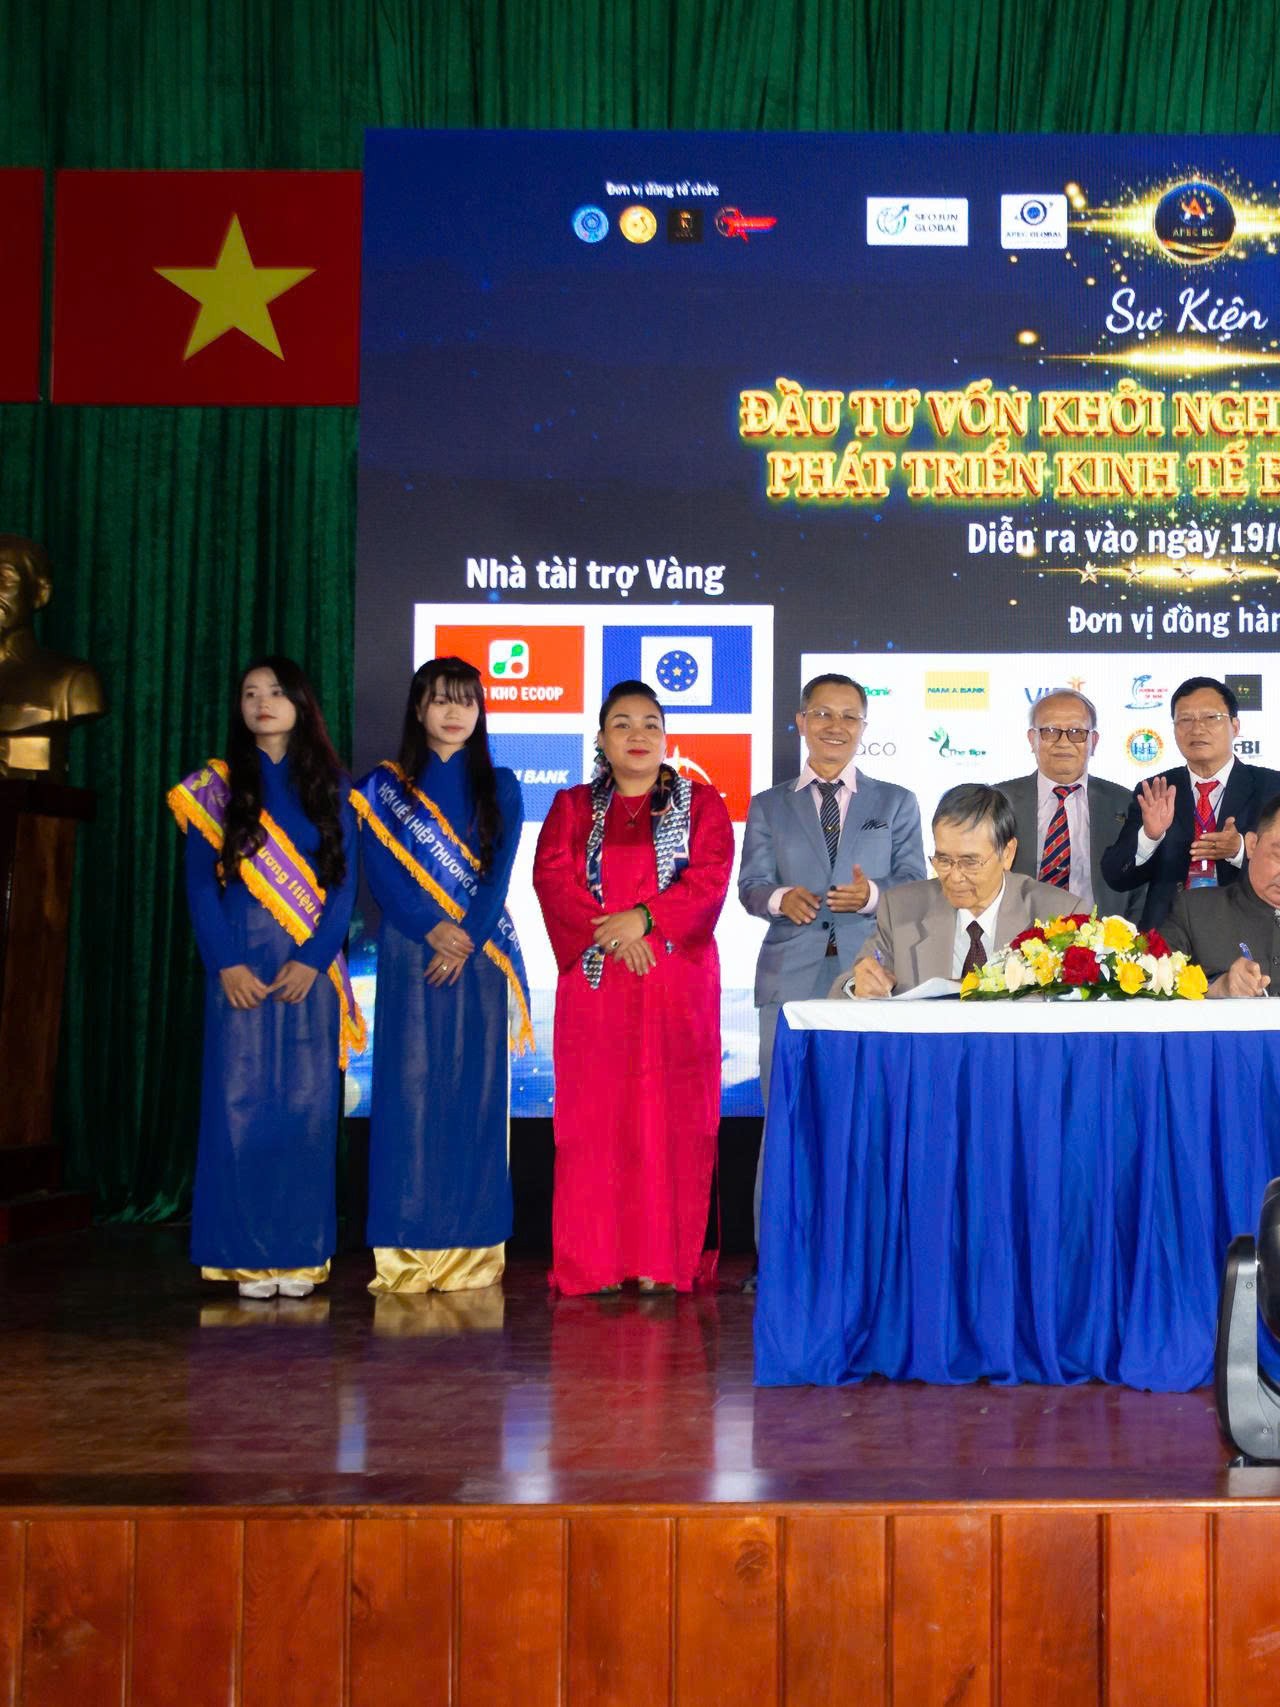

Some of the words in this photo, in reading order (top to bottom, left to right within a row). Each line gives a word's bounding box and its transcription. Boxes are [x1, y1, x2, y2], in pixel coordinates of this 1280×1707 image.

[1105, 287, 1164, 339] Sự
[1176, 287, 1268, 341] Kiện
[740, 377, 844, 438] ĐẦU
[850, 387, 920, 438] TƯ
[924, 378, 1032, 438] VỐN
[1039, 378, 1165, 438] KHỞI
[767, 441, 896, 498] PHÁT
[902, 438, 1047, 498] TRIỂN
[1053, 450, 1180, 498] KINH
[1188, 440, 1249, 498] TẾ
[968, 516, 1035, 554] Diễn
[1046, 531, 1076, 554] ra
[1086, 521, 1138, 554] vào
[1148, 522, 1222, 559] ngày
[466, 555, 526, 589] Nhà
[536, 555, 576, 589] tài
[586, 561, 639, 597] trợ
[647, 555, 726, 596] Vàng
[1068, 606, 1122, 634] Đơn
[1131, 605, 1153, 640] vị
[1162, 603, 1230, 638] đồng
[490, 686, 518, 701] KHO
[521, 686, 564, 701] ECOOP
[523, 768, 570, 784] BANK
